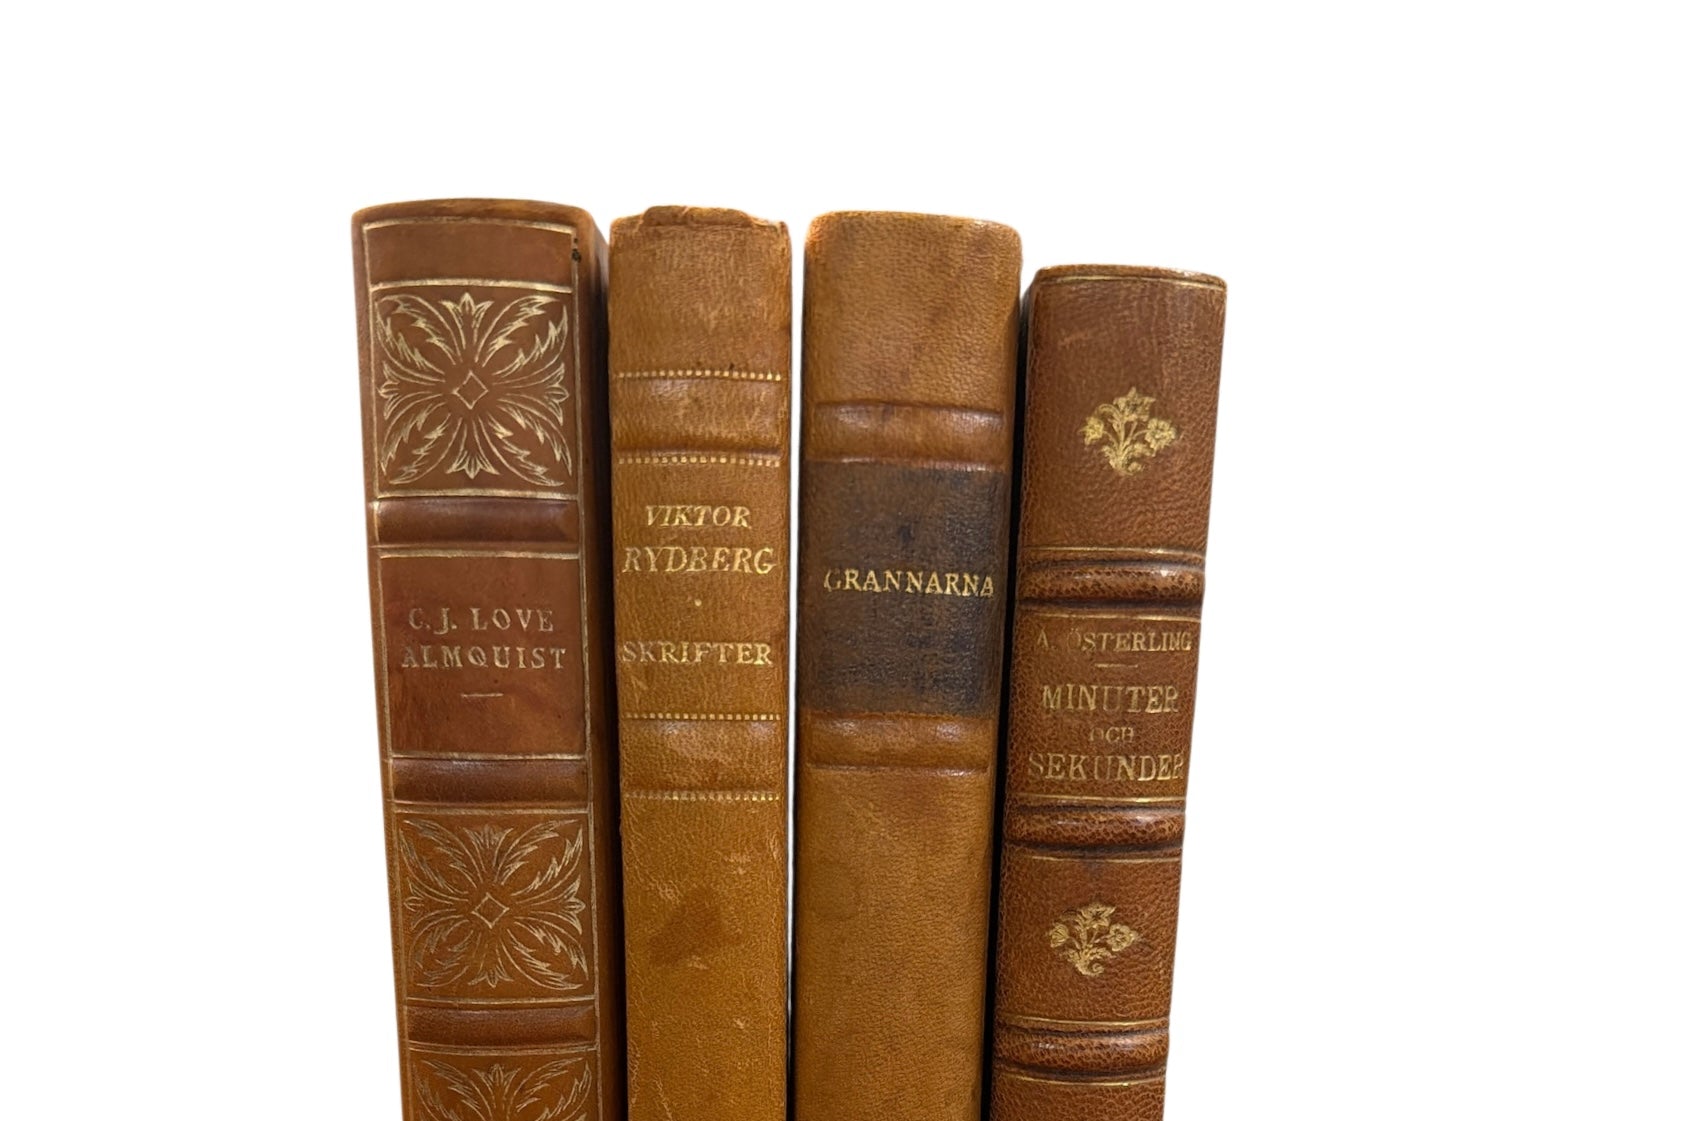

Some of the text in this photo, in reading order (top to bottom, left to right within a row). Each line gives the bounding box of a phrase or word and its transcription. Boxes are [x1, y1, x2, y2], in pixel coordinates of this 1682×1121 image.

[646, 505, 752, 529] VIKTOR
[622, 546, 776, 575] RYDBERG
[823, 568, 994, 598] GRANNARNA
[470, 607, 554, 632] LOVE
[401, 645, 566, 669] ALMQUIST
[622, 640, 773, 665] SKRIFTER
[1041, 683, 1179, 713] MINUTER
[1027, 750, 1184, 782] SEKUNDER
